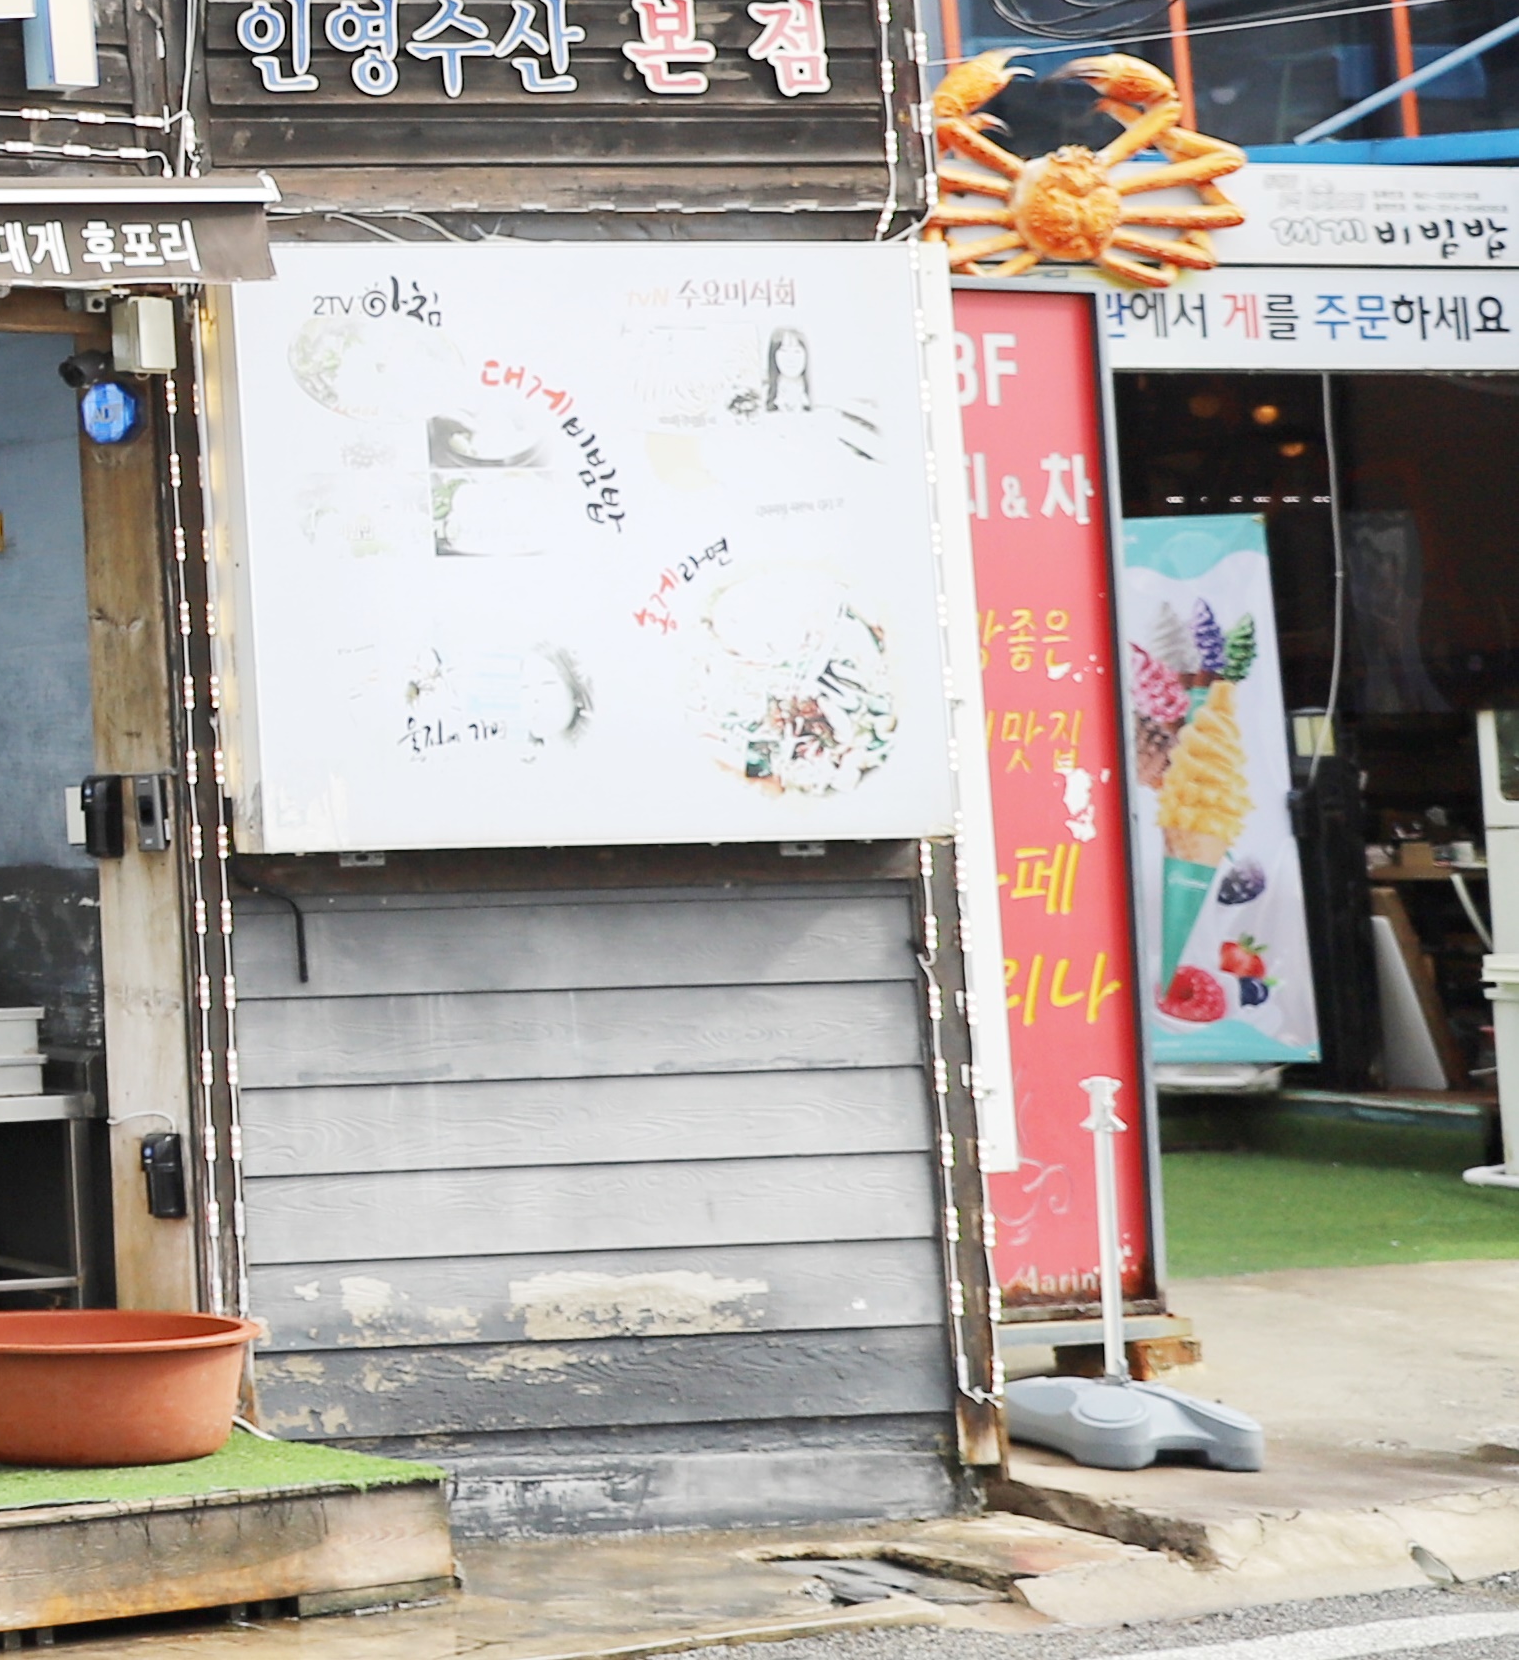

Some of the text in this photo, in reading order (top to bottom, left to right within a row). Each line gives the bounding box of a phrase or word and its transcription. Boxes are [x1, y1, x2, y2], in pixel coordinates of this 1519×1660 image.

[83, 218, 201, 276] 후포리
[313, 295, 354, 316] 2TV
[1222, 292, 1300, 341] 게를
[1315, 292, 1510, 342] 주문하세요
[985, 709, 1084, 772] 맛집
[997, 842, 1081, 915] 페
[1005, 952, 1121, 1027] 리나
[1004, 1264, 1101, 1297] Marin
